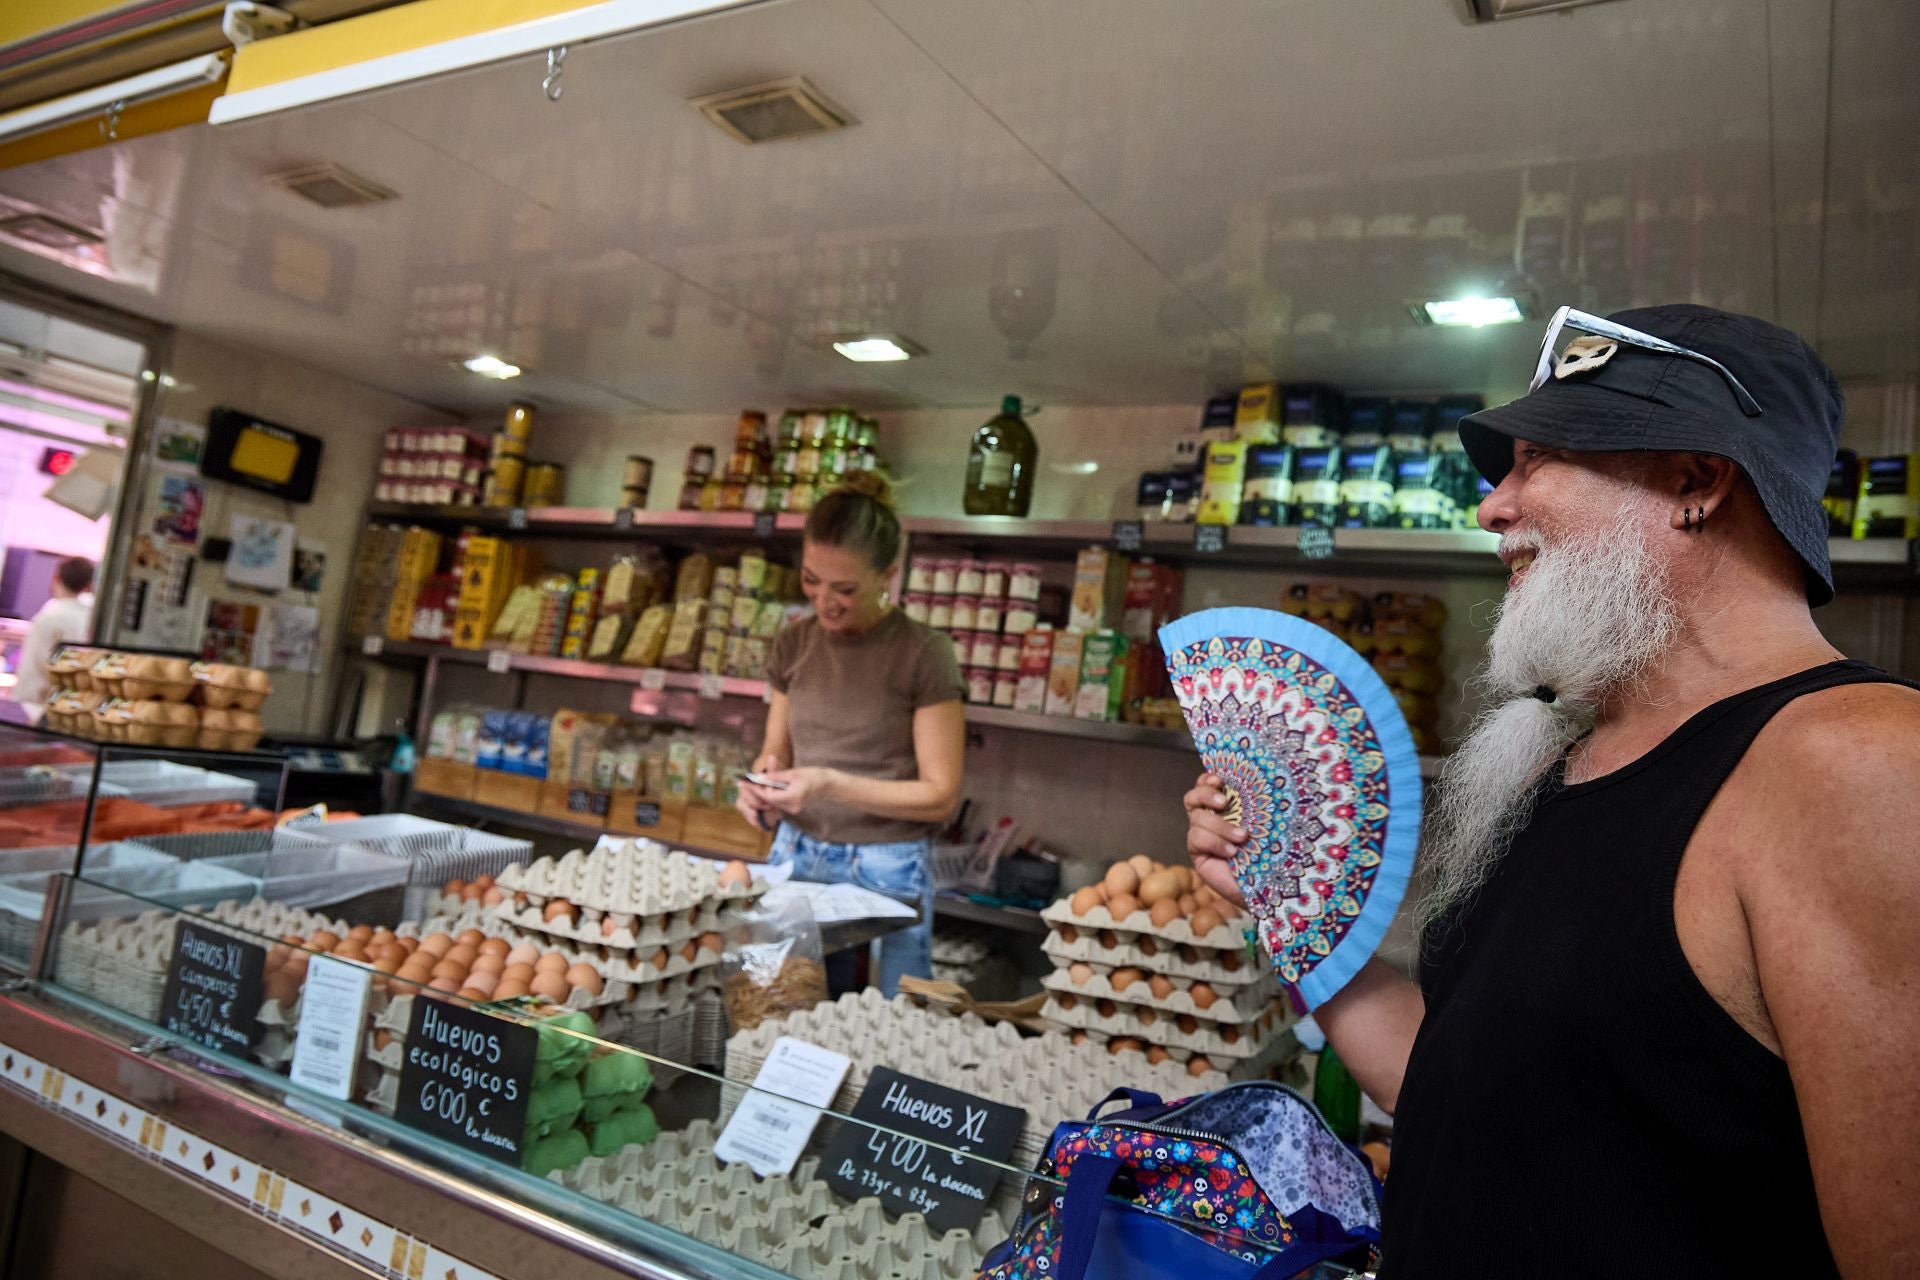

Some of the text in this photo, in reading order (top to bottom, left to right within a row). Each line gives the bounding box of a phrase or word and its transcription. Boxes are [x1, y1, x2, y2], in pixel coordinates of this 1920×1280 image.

[181, 928, 243, 979] Huevos XL
[179, 965, 238, 1000] camperos
[220, 1001, 232, 1018] €
[422, 1004, 501, 1064] Huevos
[409, 1046, 518, 1100] ecológicos
[478, 1098, 492, 1116] €
[881, 1080, 989, 1144] Huevos XL
[465, 1116, 517, 1151] la docena
[837, 1158, 941, 1214] De 73gr a 83gr
[921, 1164, 984, 1200] la docena
